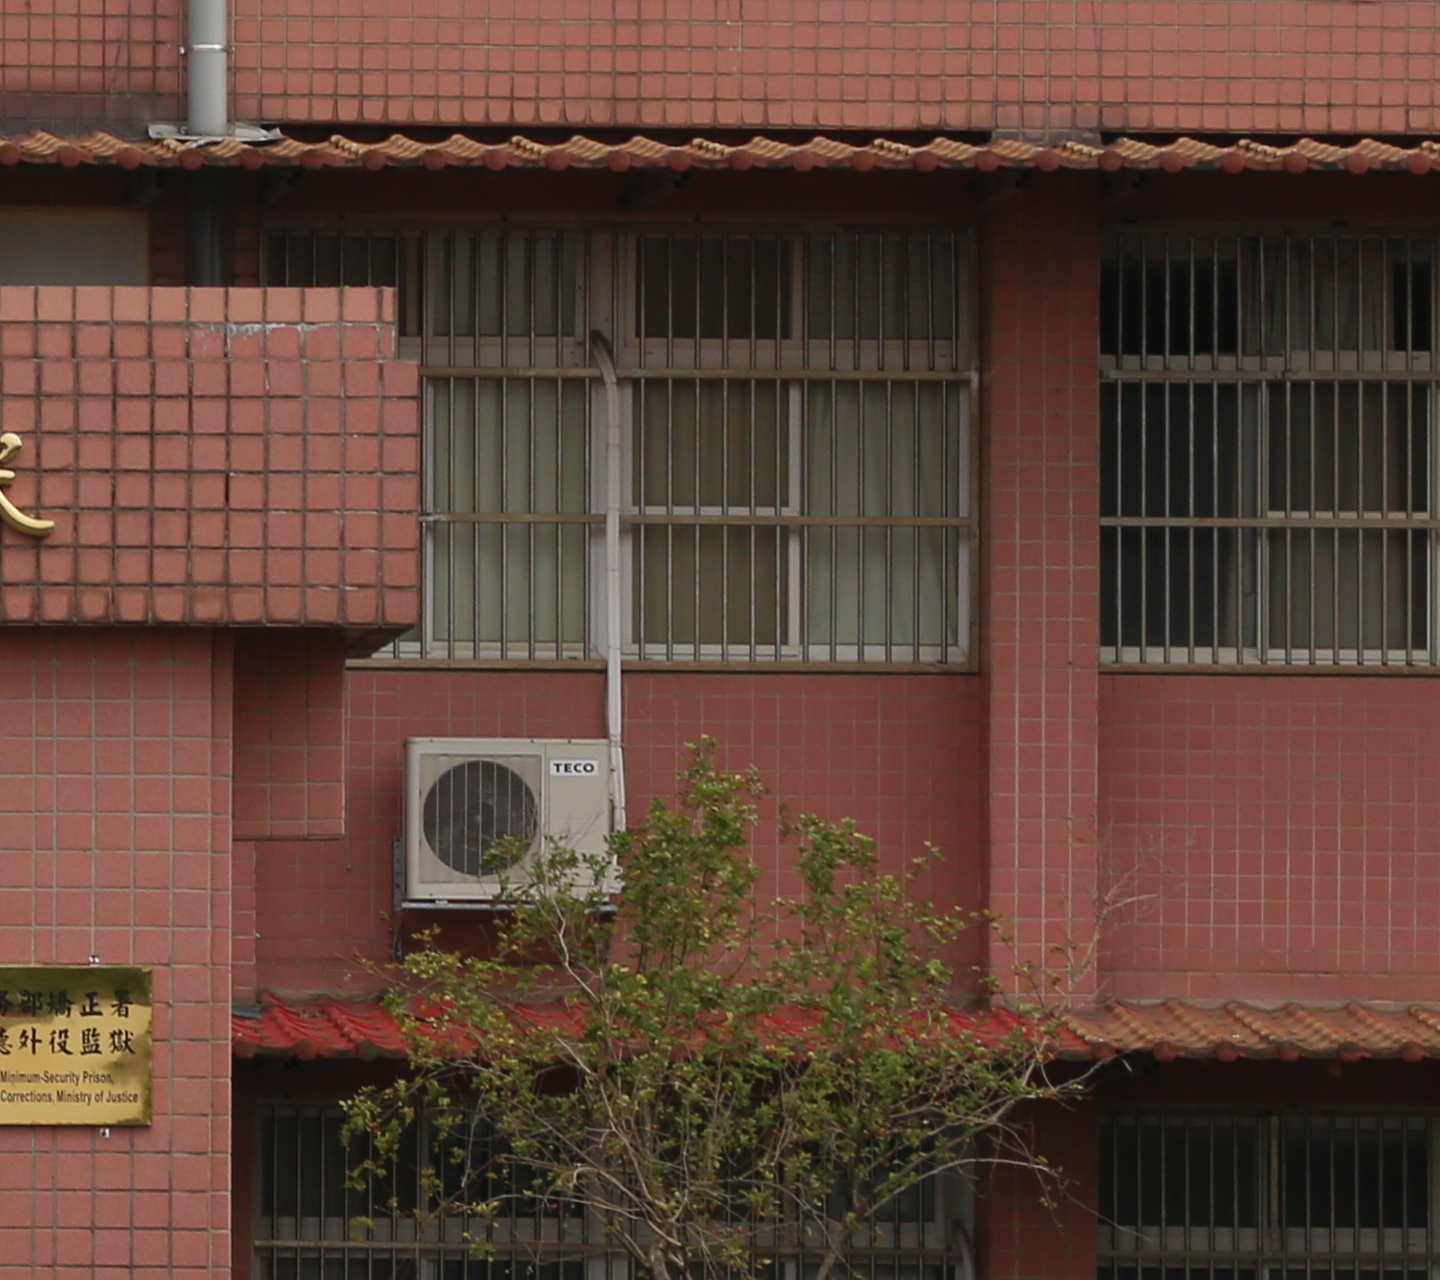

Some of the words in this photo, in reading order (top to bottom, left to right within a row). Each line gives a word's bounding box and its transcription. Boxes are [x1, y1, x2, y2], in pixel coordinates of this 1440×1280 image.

[553, 762, 595, 774] TECO
[0, 1070, 81, 1087] Minimum-Security
[82, 1070, 115, 1085] Prison,
[0, 1091, 55, 1105] Corrections,
[56, 1090, 92, 1106] Ministry
[95, 1091, 105, 1103] of
[106, 1091, 139, 1104] Justice
